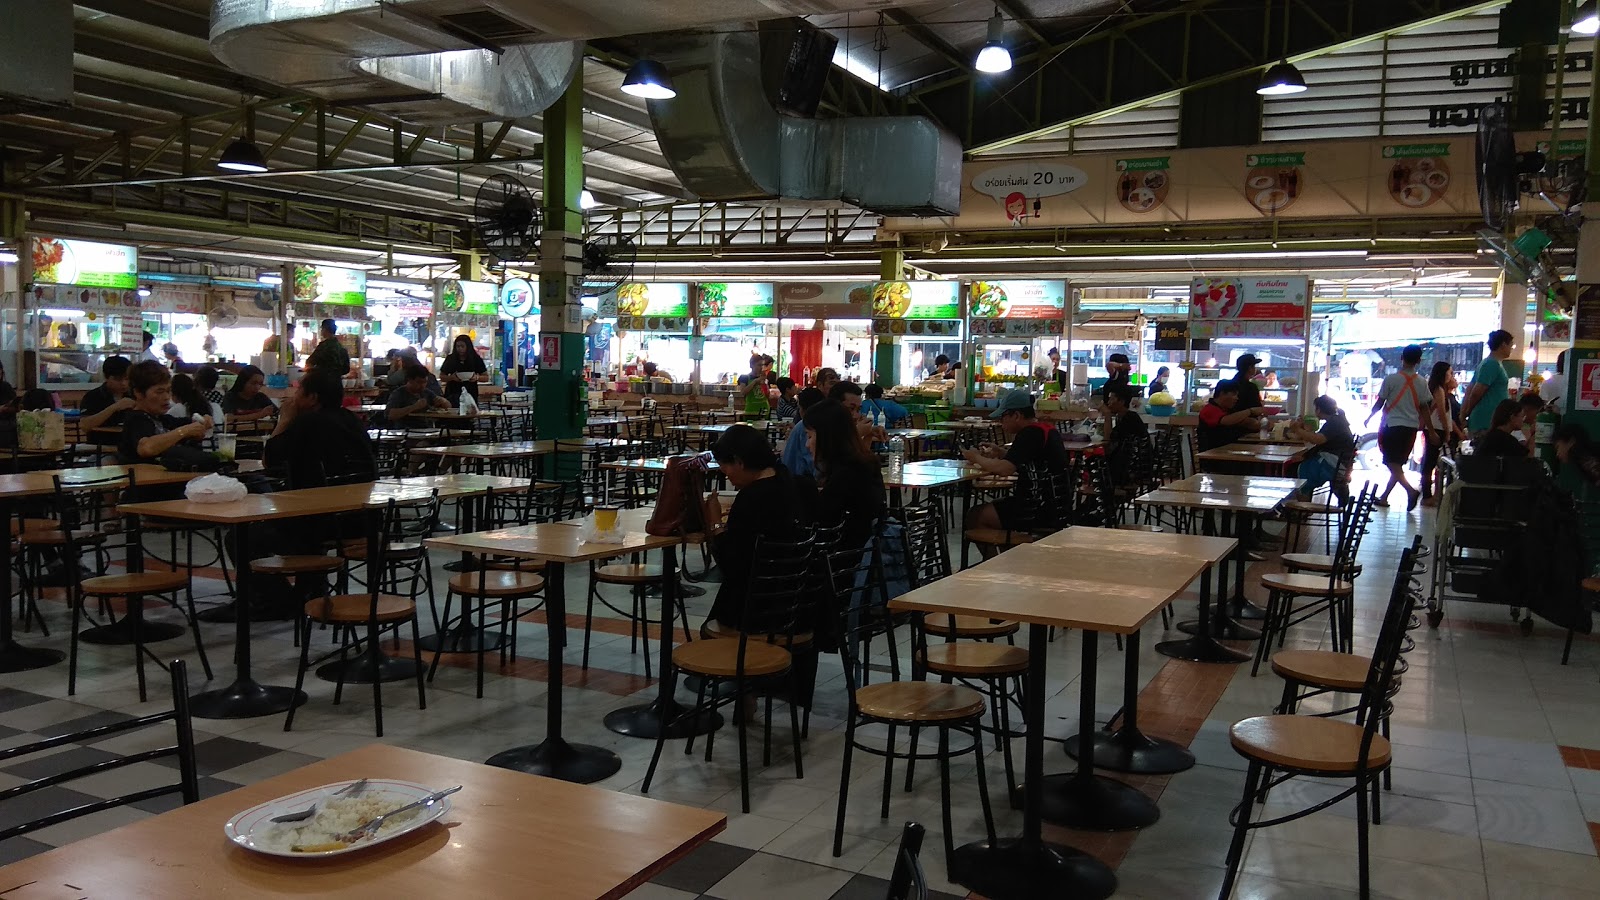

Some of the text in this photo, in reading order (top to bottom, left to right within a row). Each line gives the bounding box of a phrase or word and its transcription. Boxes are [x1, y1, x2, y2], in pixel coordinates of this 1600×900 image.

[985, 171, 1075, 188] อร่อยเริ่มต้น 20 บาท
